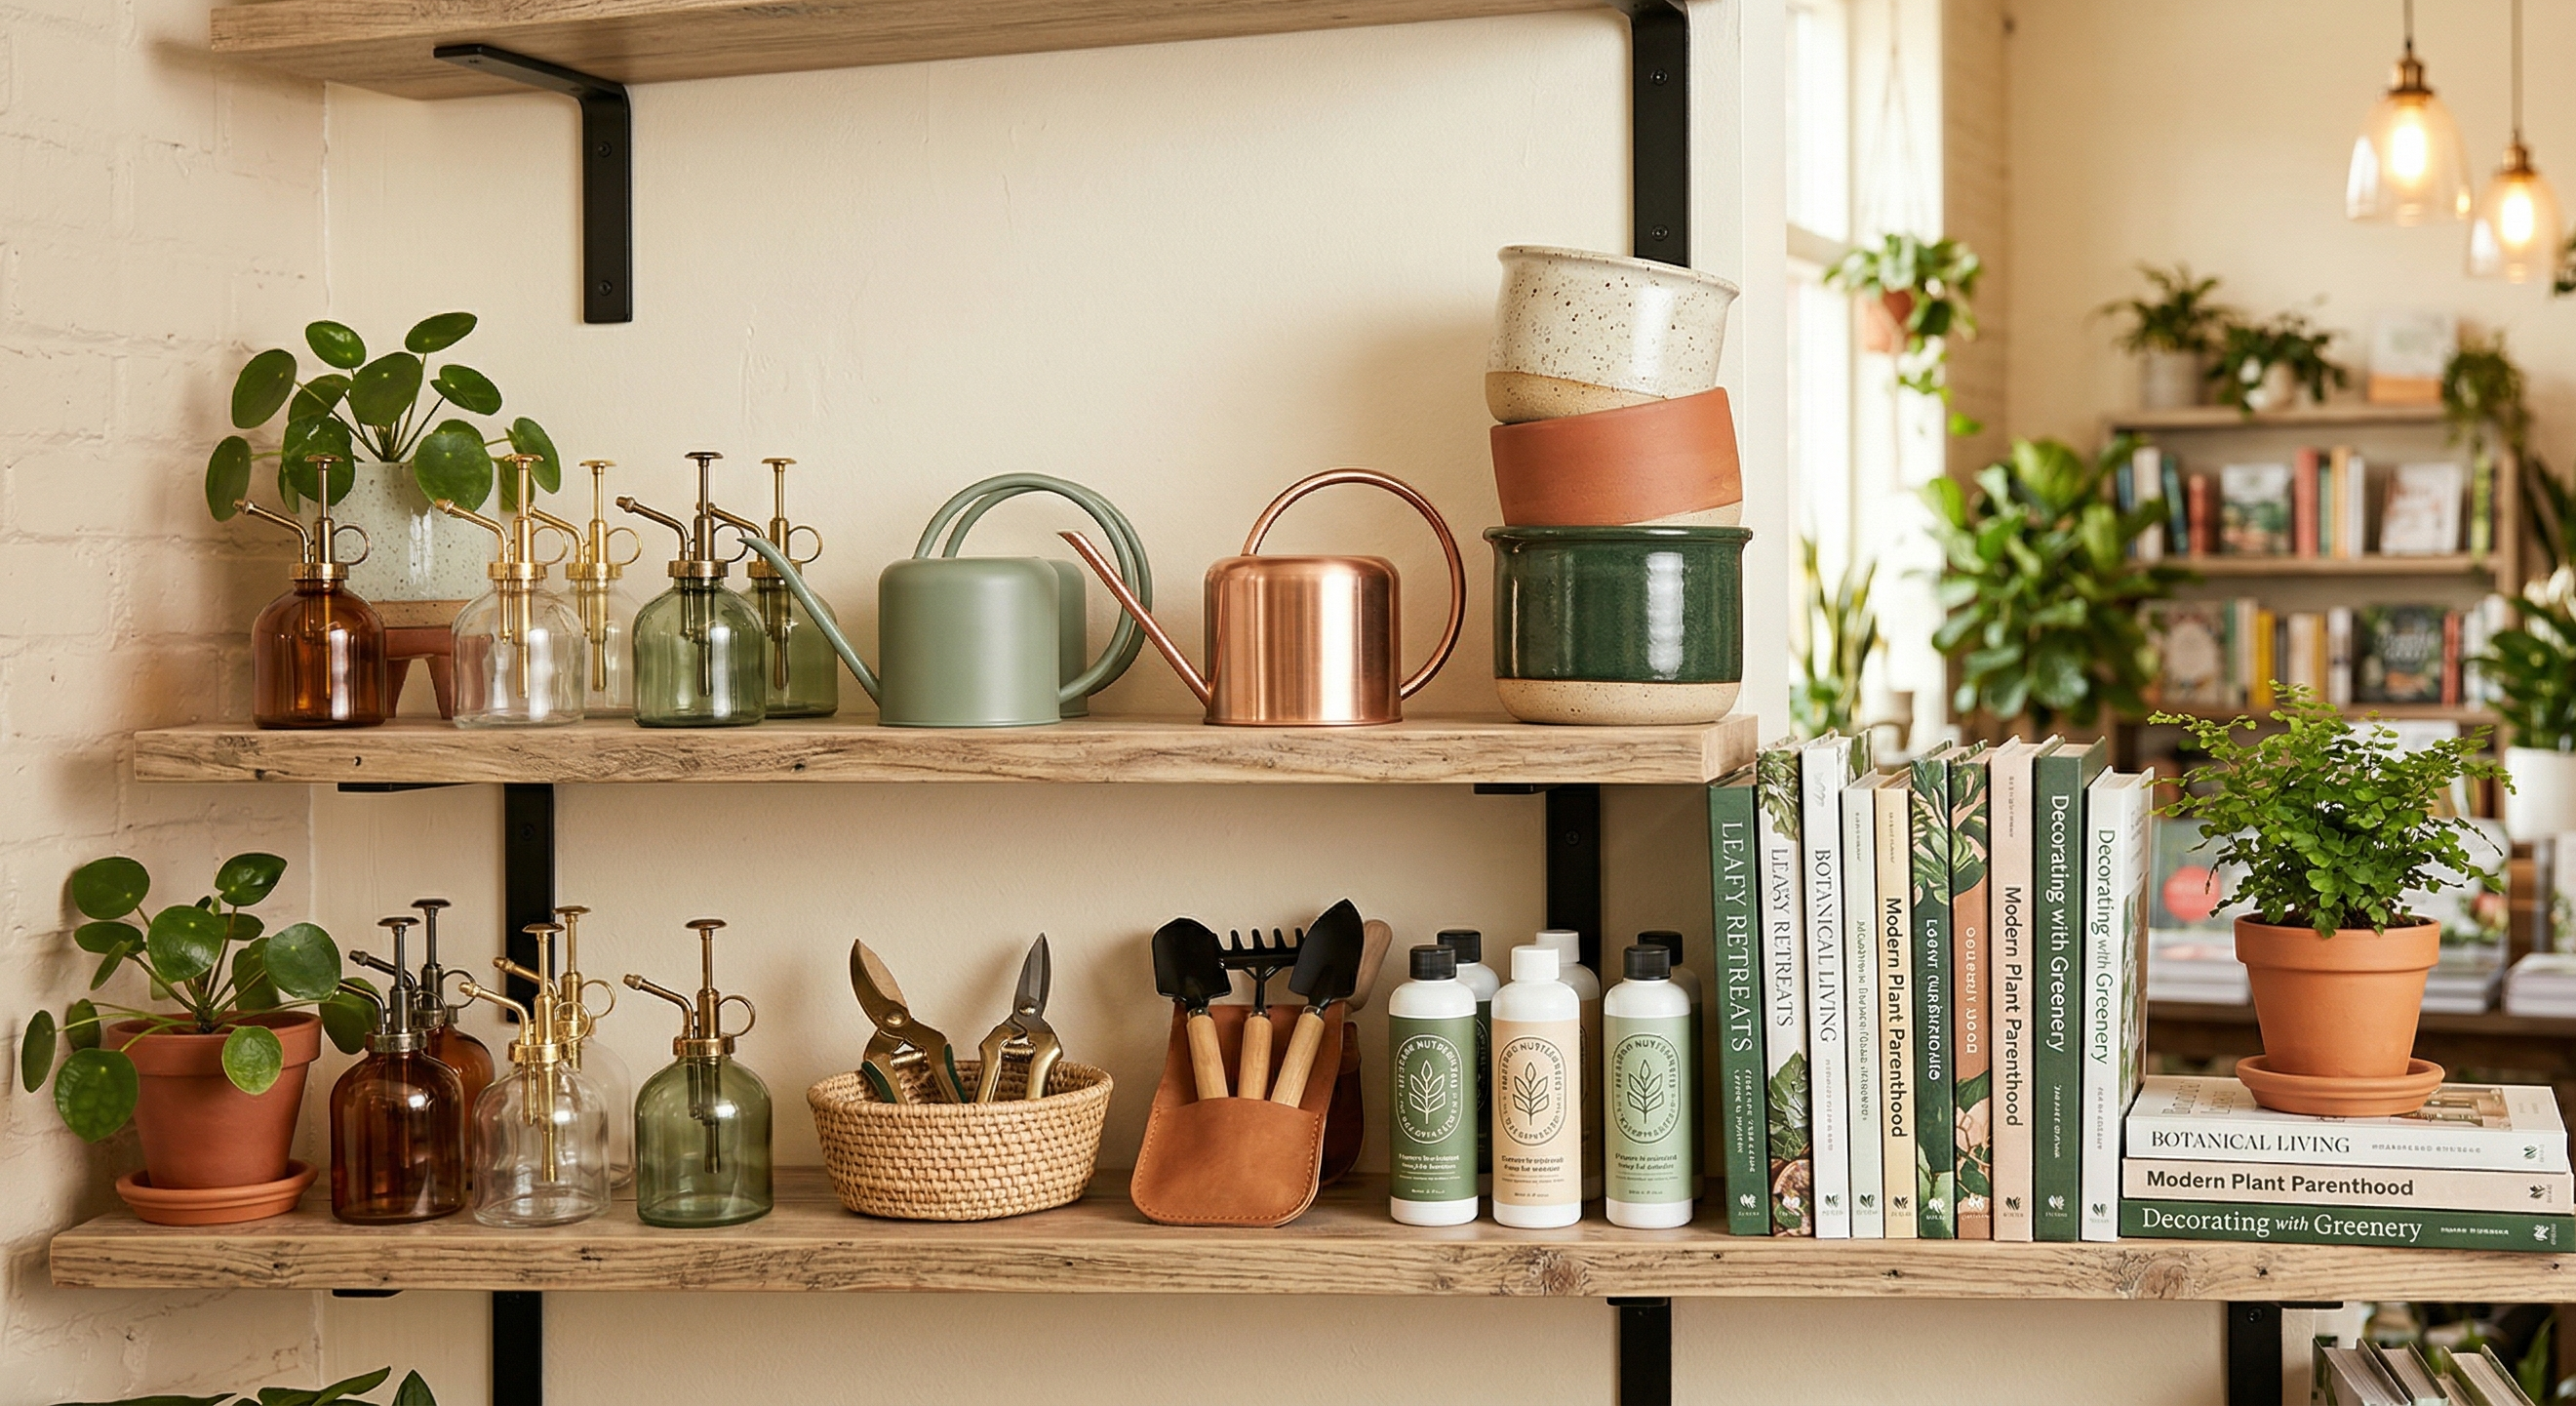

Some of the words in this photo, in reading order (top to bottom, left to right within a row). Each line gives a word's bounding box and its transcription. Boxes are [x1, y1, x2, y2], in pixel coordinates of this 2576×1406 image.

[1722, 822, 1747, 906] LEAFY
[2045, 795, 2070, 903] Decorating
[2090, 829, 2116, 936] Decorating
[1814, 849, 1835, 965] BOTANICAL
[1885, 898, 1902, 968] Modern
[2004, 887, 2023, 957] Modern
[2050, 907, 2070, 951] with
[1726, 914, 1753, 1052] RETREATS
[1773, 921, 1794, 1027] RETREATS
[1818, 971, 1838, 1042] LIVING
[1887, 974, 1905, 1023] Plant
[2005, 964, 2023, 1013] Plant
[2045, 956, 2070, 1053] Greenery
[2090, 973, 2114, 1065] Greenery
[1889, 1028, 1908, 1137] Parenthood
[2005, 1019, 2023, 1126] Parenthood
[2147, 1171, 2225, 1189] Modern
[2232, 1173, 2285, 1191] Plant
[2292, 1176, 2414, 1195] Parenthood
[2152, 1131, 2271, 1150] BOTANICAL
[2278, 1136, 2350, 1153] LIVING
[2142, 1208, 2270, 1237] Decorating
[2276, 1216, 2309, 1231] with
[2314, 1215, 2423, 1242] Greenery
